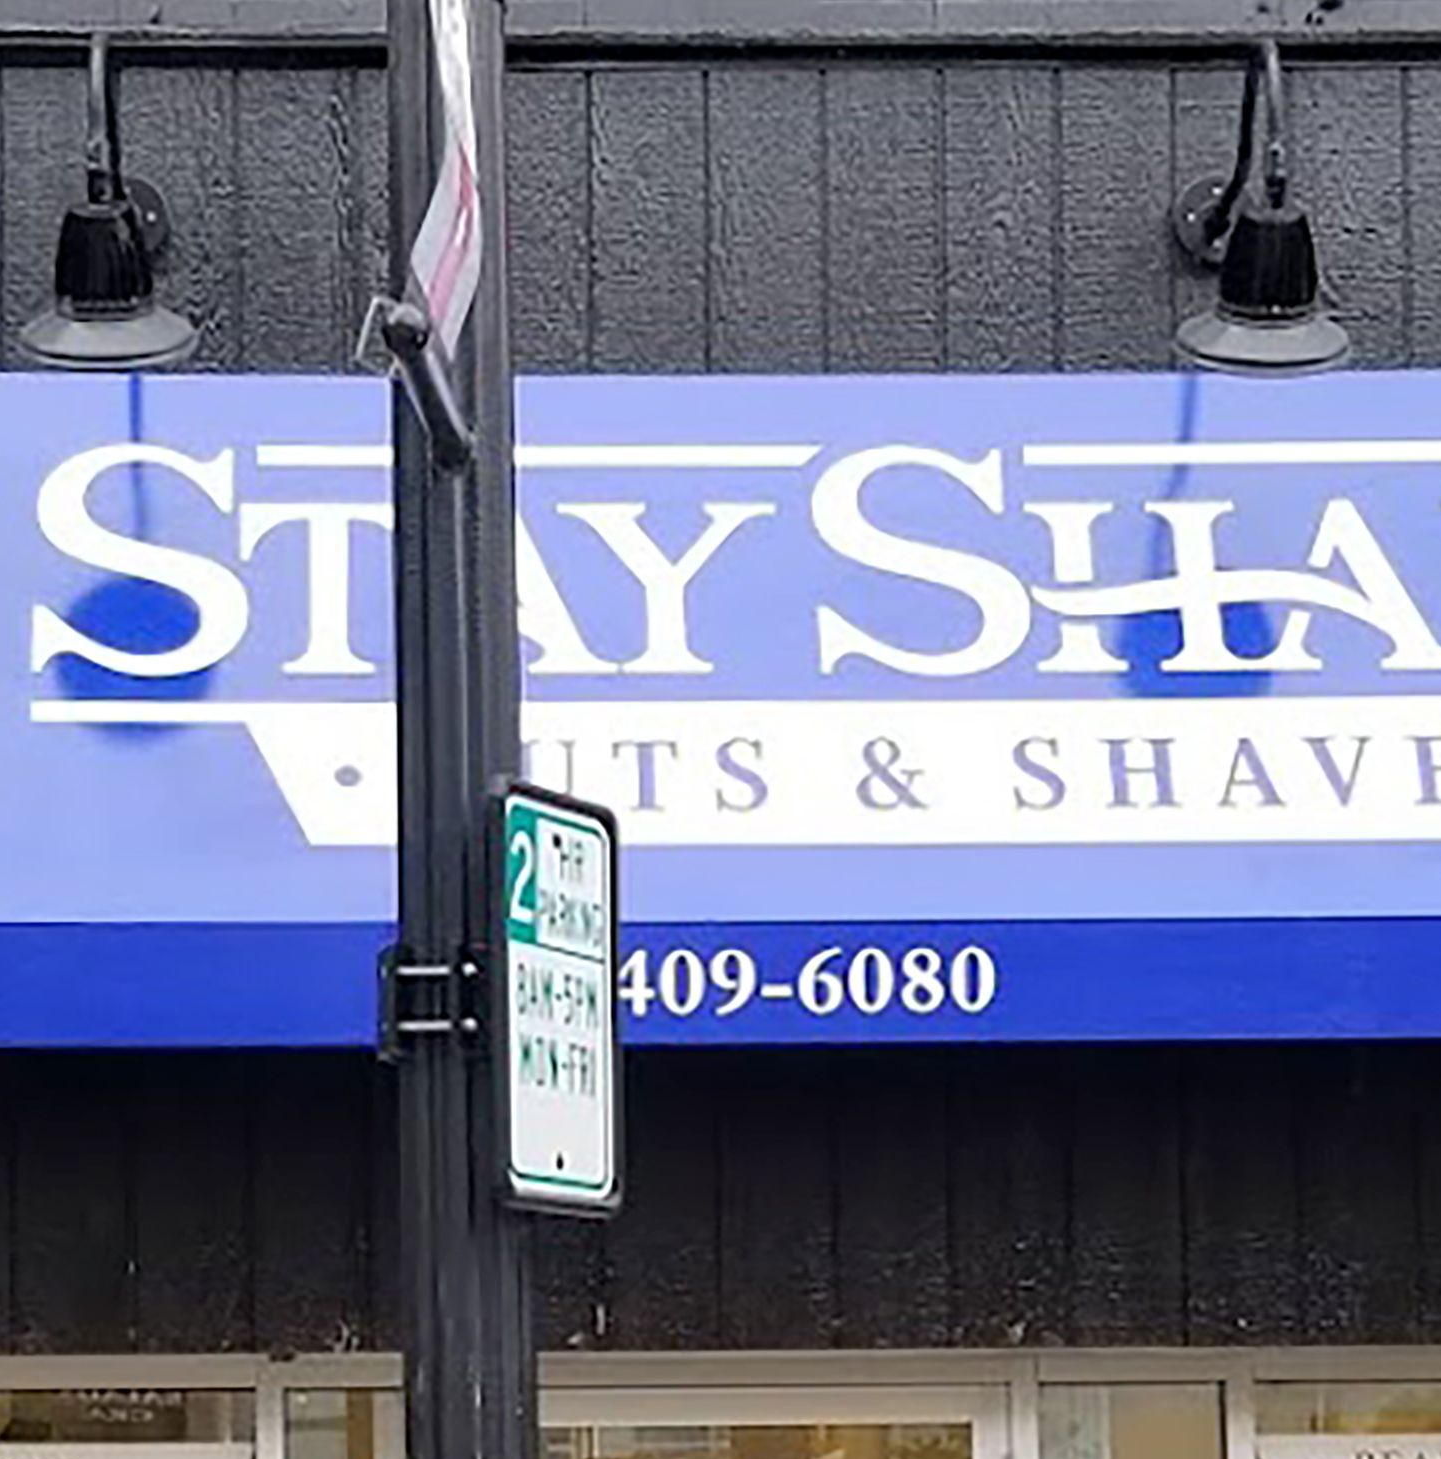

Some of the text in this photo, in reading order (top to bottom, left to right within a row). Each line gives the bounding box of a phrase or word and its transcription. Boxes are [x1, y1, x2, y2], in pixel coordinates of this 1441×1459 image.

[521, 736, 769, 813] UTS
[855, 736, 930, 812] &
[510, 830, 534, 922] 2
[617, 947, 998, 1018] 409-6080
[517, 1032, 596, 1097] MON-FRI
